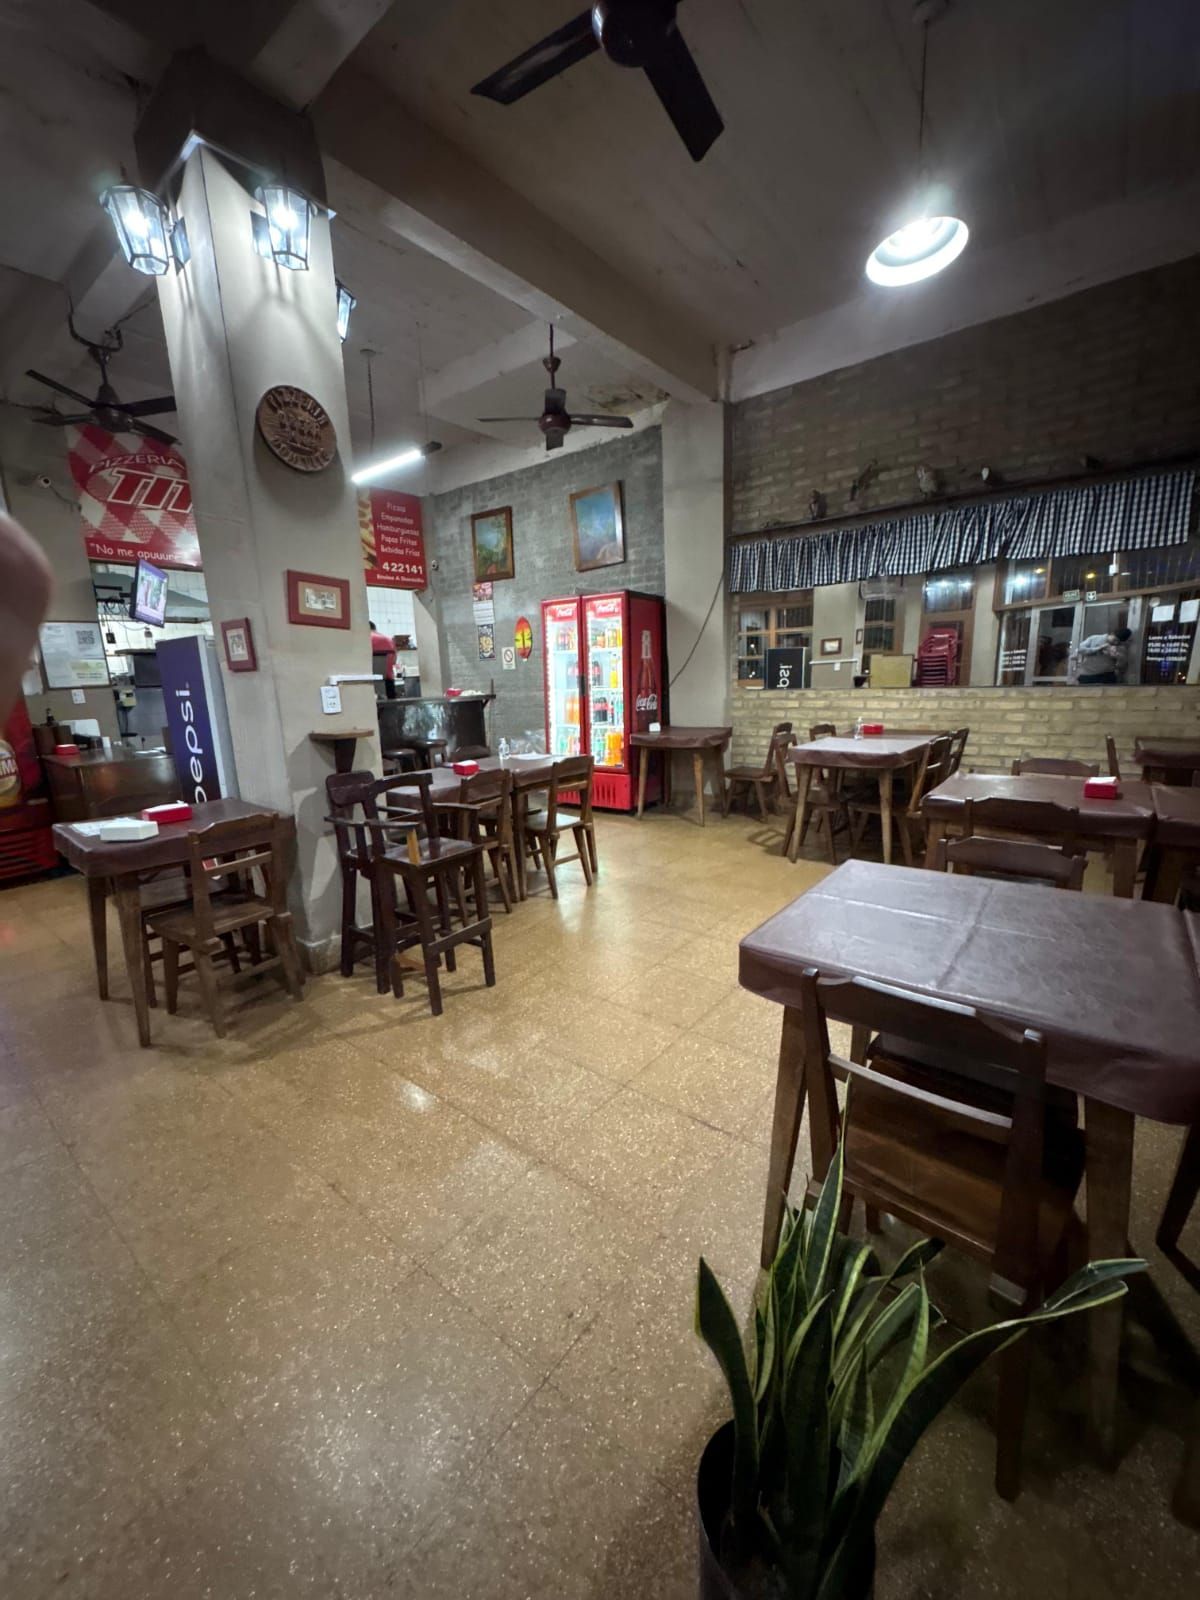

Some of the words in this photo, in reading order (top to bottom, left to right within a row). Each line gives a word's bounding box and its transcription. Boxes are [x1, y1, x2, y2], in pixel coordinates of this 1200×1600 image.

[88, 454, 185, 473] PIZZERIA
[107, 467, 193, 514] TIT
[380, 511, 414, 525] Empanadas
[376, 522, 420, 536] Hamburguesas
[381, 533, 398, 545] Papas
[399, 536, 417, 546] Fritas
[117, 547, 135, 557] me
[380, 544, 404, 555] Bebidas
[382, 561, 423, 575] 422141
